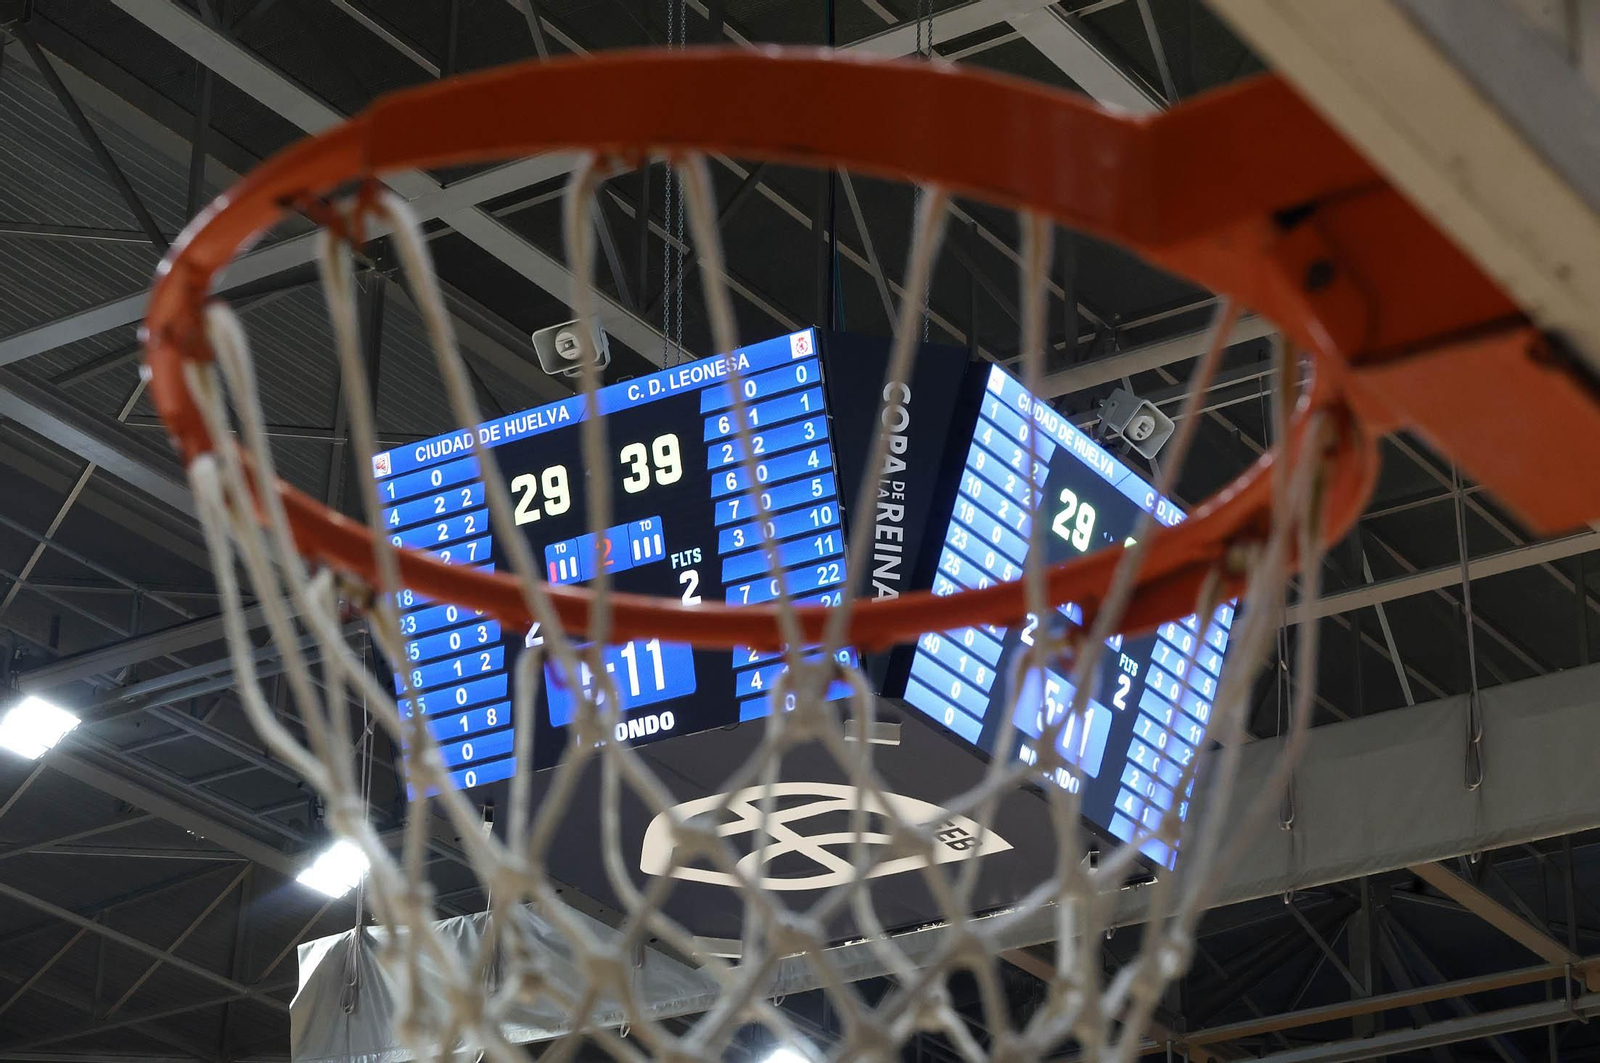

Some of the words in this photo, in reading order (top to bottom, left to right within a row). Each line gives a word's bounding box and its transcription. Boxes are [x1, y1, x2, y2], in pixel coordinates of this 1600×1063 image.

[627, 385, 645, 401] C.
[648, 379, 666, 394] D.
[669, 353, 750, 389] LEONESA
[744, 380, 757, 398] 0
[796, 365, 808, 383] 0
[718, 416, 730, 434] 6
[748, 408, 759, 426] 1
[800, 393, 810, 412] 1
[881, 381, 912, 475] COPA
[991, 402, 999, 419] 1
[1019, 424, 1028, 442] 0
[415, 432, 474, 462] CIUDAD
[479, 425, 501, 444] DE
[504, 405, 570, 437] HUELVA
[722, 445, 734, 463] 2
[752, 436, 765, 454] 2
[803, 422, 815, 440] 3
[982, 428, 993, 445] 4
[1011, 449, 1022, 467] 2
[1018, 392, 1058, 433] CIUDAD
[1057, 422, 1075, 445] DE
[1073, 432, 1114, 478] HUELVA
[620, 433, 682, 494] 39
[726, 472, 738, 490] 6
[756, 464, 768, 482] 0
[808, 450, 819, 468] 4
[976, 452, 986, 470] 9
[1004, 475, 1016, 493] 2
[386, 481, 396, 499] 1
[431, 469, 442, 486] 0
[510, 464, 571, 526] 29
[728, 500, 740, 520] 7
[760, 493, 772, 510] 0
[811, 478, 822, 498] 5
[892, 480, 906, 501] DE
[390, 508, 400, 526] 4
[434, 496, 446, 514] 2
[460, 488, 472, 507] 2
[966, 476, 982, 498] 10
[998, 501, 1009, 518] 2
[1016, 512, 1026, 530] 7
[1156, 500, 1167, 520] D.
[437, 523, 450, 541] 2
[464, 516, 476, 534] 2
[640, 519, 652, 532] TO
[733, 528, 744, 547] 3
[763, 522, 776, 538] 0
[810, 506, 832, 527] 10
[960, 502, 974, 524] 18
[992, 525, 1002, 544] 0
[1052, 488, 1096, 552] 29
[466, 542, 478, 561] 7
[554, 542, 567, 554] TO
[594, 538, 614, 566] 2
[671, 547, 702, 570] FLTS
[814, 534, 834, 556] 11
[872, 502, 906, 602] REINA
[950, 526, 968, 550] 23
[985, 552, 996, 570] 0
[1002, 563, 1014, 582] 5
[944, 553, 962, 576] 25
[395, 588, 414, 608] 18
[678, 569, 702, 607] 2
[740, 585, 750, 604] 7
[816, 564, 840, 586] 22
[400, 616, 417, 635] 23
[446, 605, 458, 622] 0
[1020, 612, 1038, 647] 2
[1222, 607, 1228, 623] 1
[406, 642, 420, 662] 5
[449, 632, 460, 650] 0
[478, 625, 488, 643] 3
[964, 628, 974, 648] 0
[1166, 623, 1176, 640] 6
[1182, 634, 1191, 652] 0
[1214, 630, 1222, 648] 3
[453, 660, 462, 676] 1
[480, 652, 492, 671] 2
[924, 632, 940, 654] 40
[960, 656, 967, 672] 1
[976, 666, 986, 684] 8
[1118, 652, 1138, 677] FLTS
[1160, 646, 1170, 664] 7
[1176, 659, 1185, 676] 0
[1208, 655, 1217, 672] 4
[750, 671, 762, 690] 4
[951, 681, 962, 700] 0
[1113, 674, 1131, 711] 2
[1154, 671, 1163, 689] 3
[1170, 684, 1179, 701] 0
[1202, 678, 1212, 696] 5
[456, 688, 468, 704] 0
[785, 694, 796, 712] 0
[460, 715, 468, 732] 1
[486, 708, 498, 726] 8
[944, 707, 955, 726] 0
[1166, 708, 1172, 725] 1
[1195, 700, 1208, 722] 10
[598, 711, 675, 746] ONDO
[1142, 720, 1152, 736] 7
[1158, 732, 1168, 750] 0
[1190, 725, 1202, 746] 11
[462, 743, 474, 760] 0
[1134, 746, 1146, 764] 2
[465, 770, 476, 788] 0
[1129, 770, 1140, 788] 2
[1124, 796, 1133, 813] 4
[1142, 808, 1149, 822] 1
